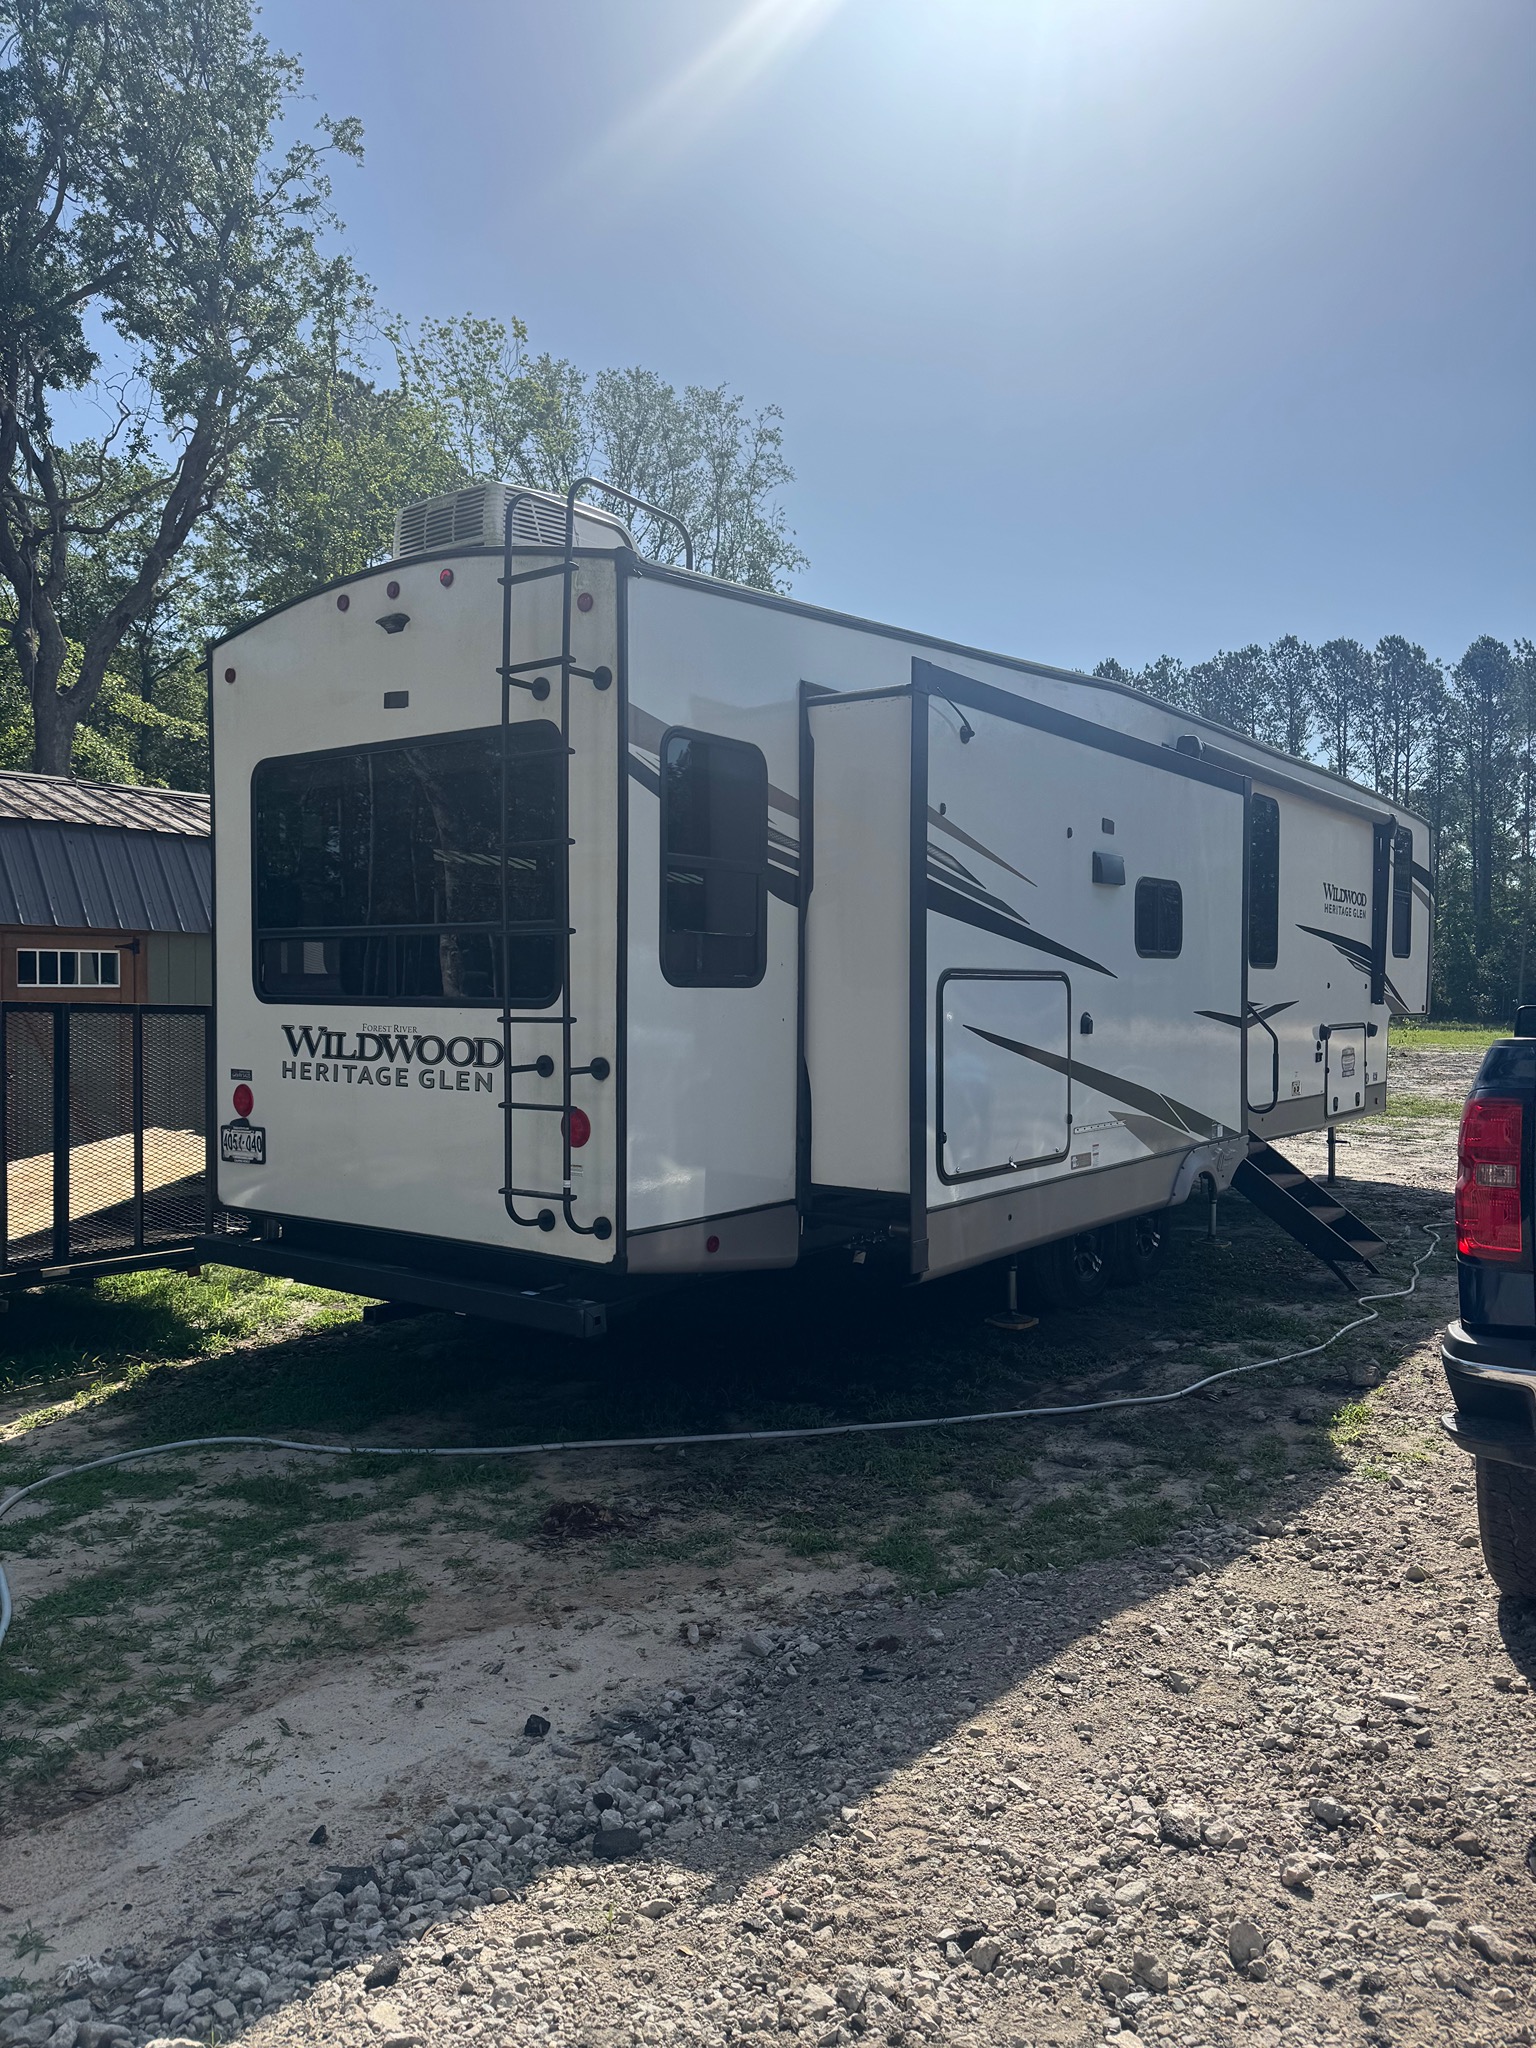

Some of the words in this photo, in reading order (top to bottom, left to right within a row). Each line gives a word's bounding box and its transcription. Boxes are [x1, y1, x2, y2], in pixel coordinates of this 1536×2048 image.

[1323, 882, 1367, 907] WILDWOOD
[1324, 903, 1352, 917] HERITAGE
[1353, 908, 1367, 919] GLEN
[362, 1023, 391, 1033] FOREST
[393, 1024, 418, 1034] RIVER
[281, 1024, 504, 1068] WILDWOOD
[281, 1060, 409, 1088] HERITAGE
[418, 1068, 493, 1093] GLEN
